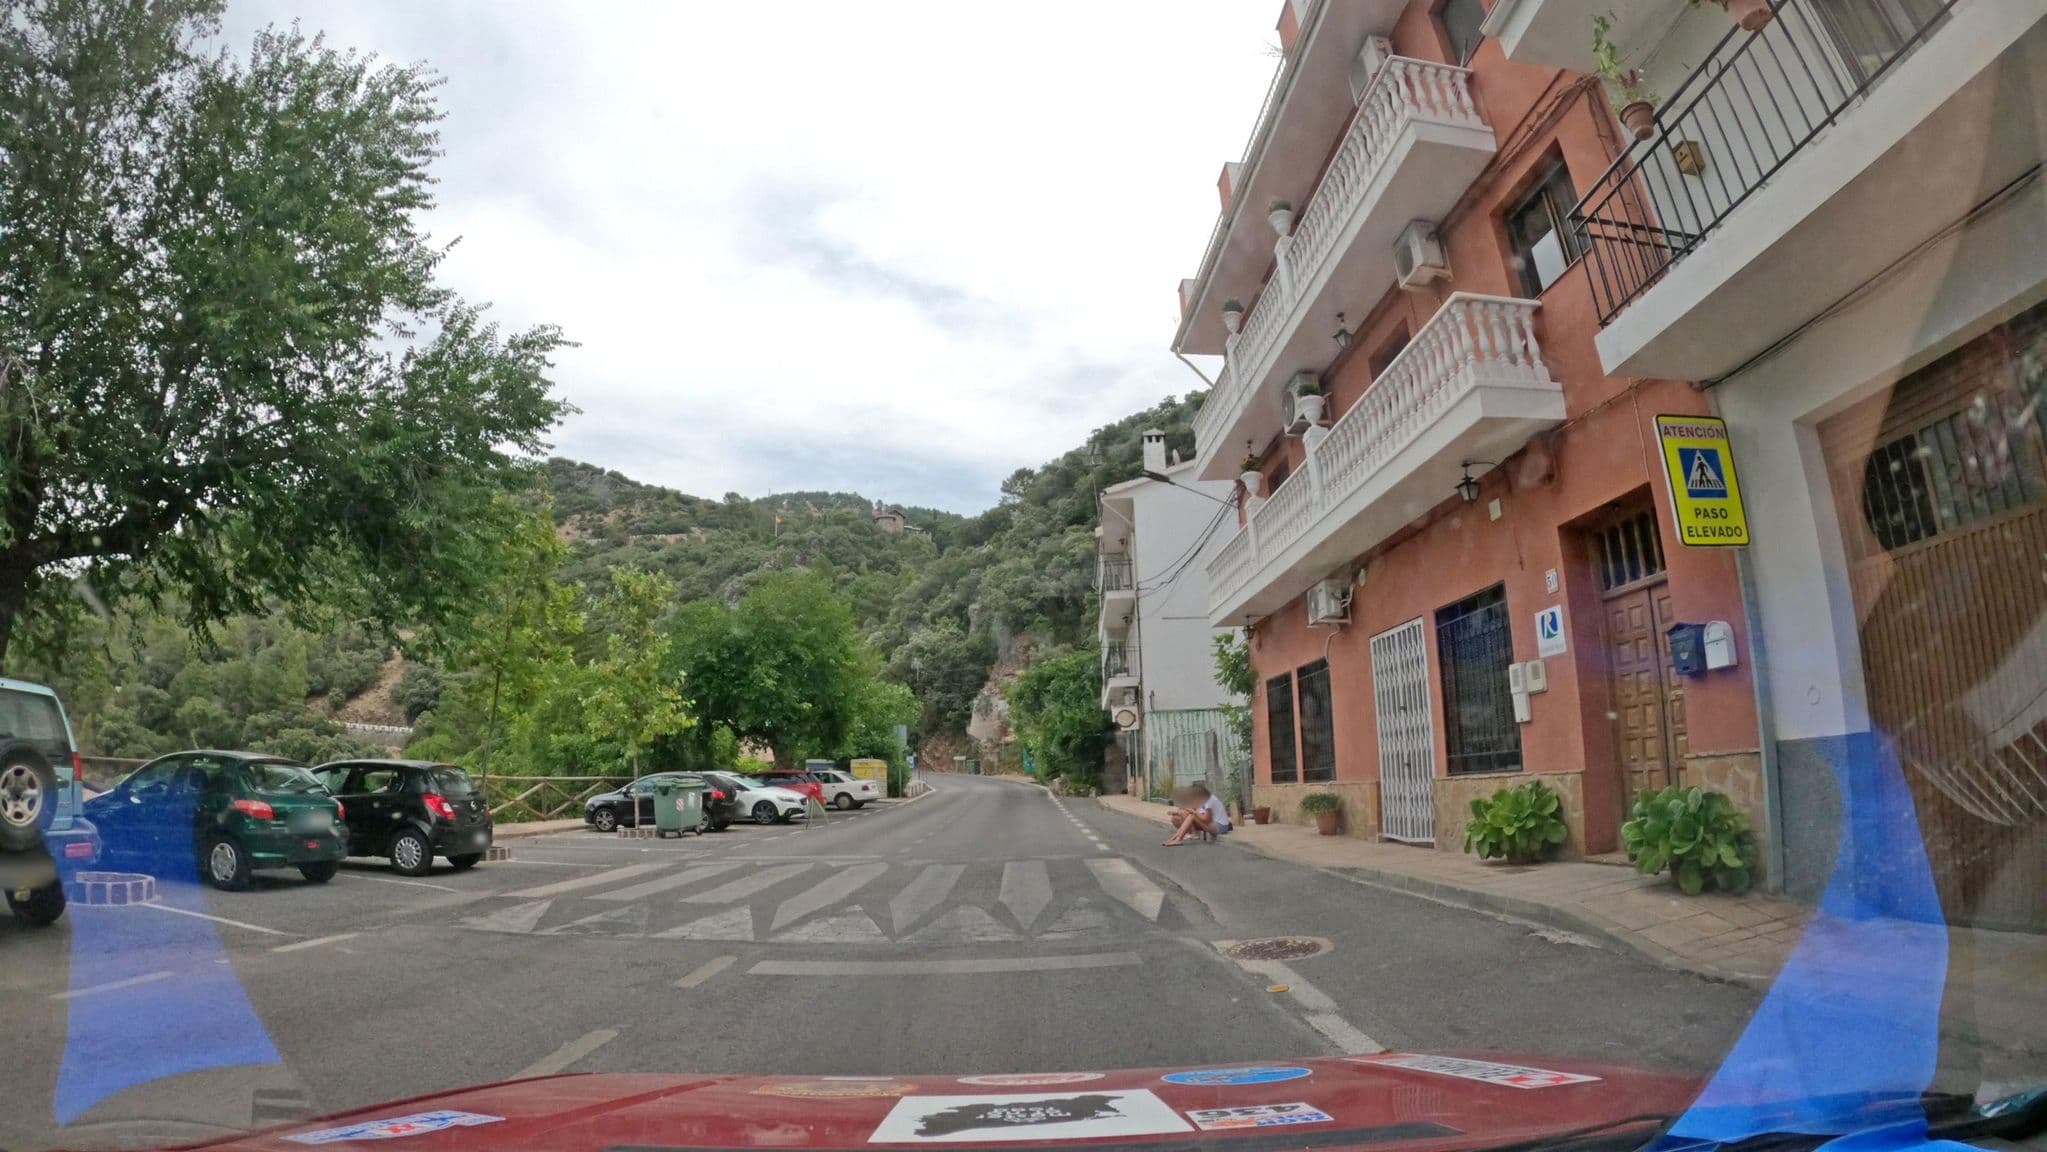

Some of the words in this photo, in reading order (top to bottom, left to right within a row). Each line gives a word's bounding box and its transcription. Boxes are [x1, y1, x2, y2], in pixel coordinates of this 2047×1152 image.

[1662, 424, 1725, 439] ATENCIÓN
[1694, 507, 1729, 520] PASO
[1686, 525, 1743, 538] ELEVADO
